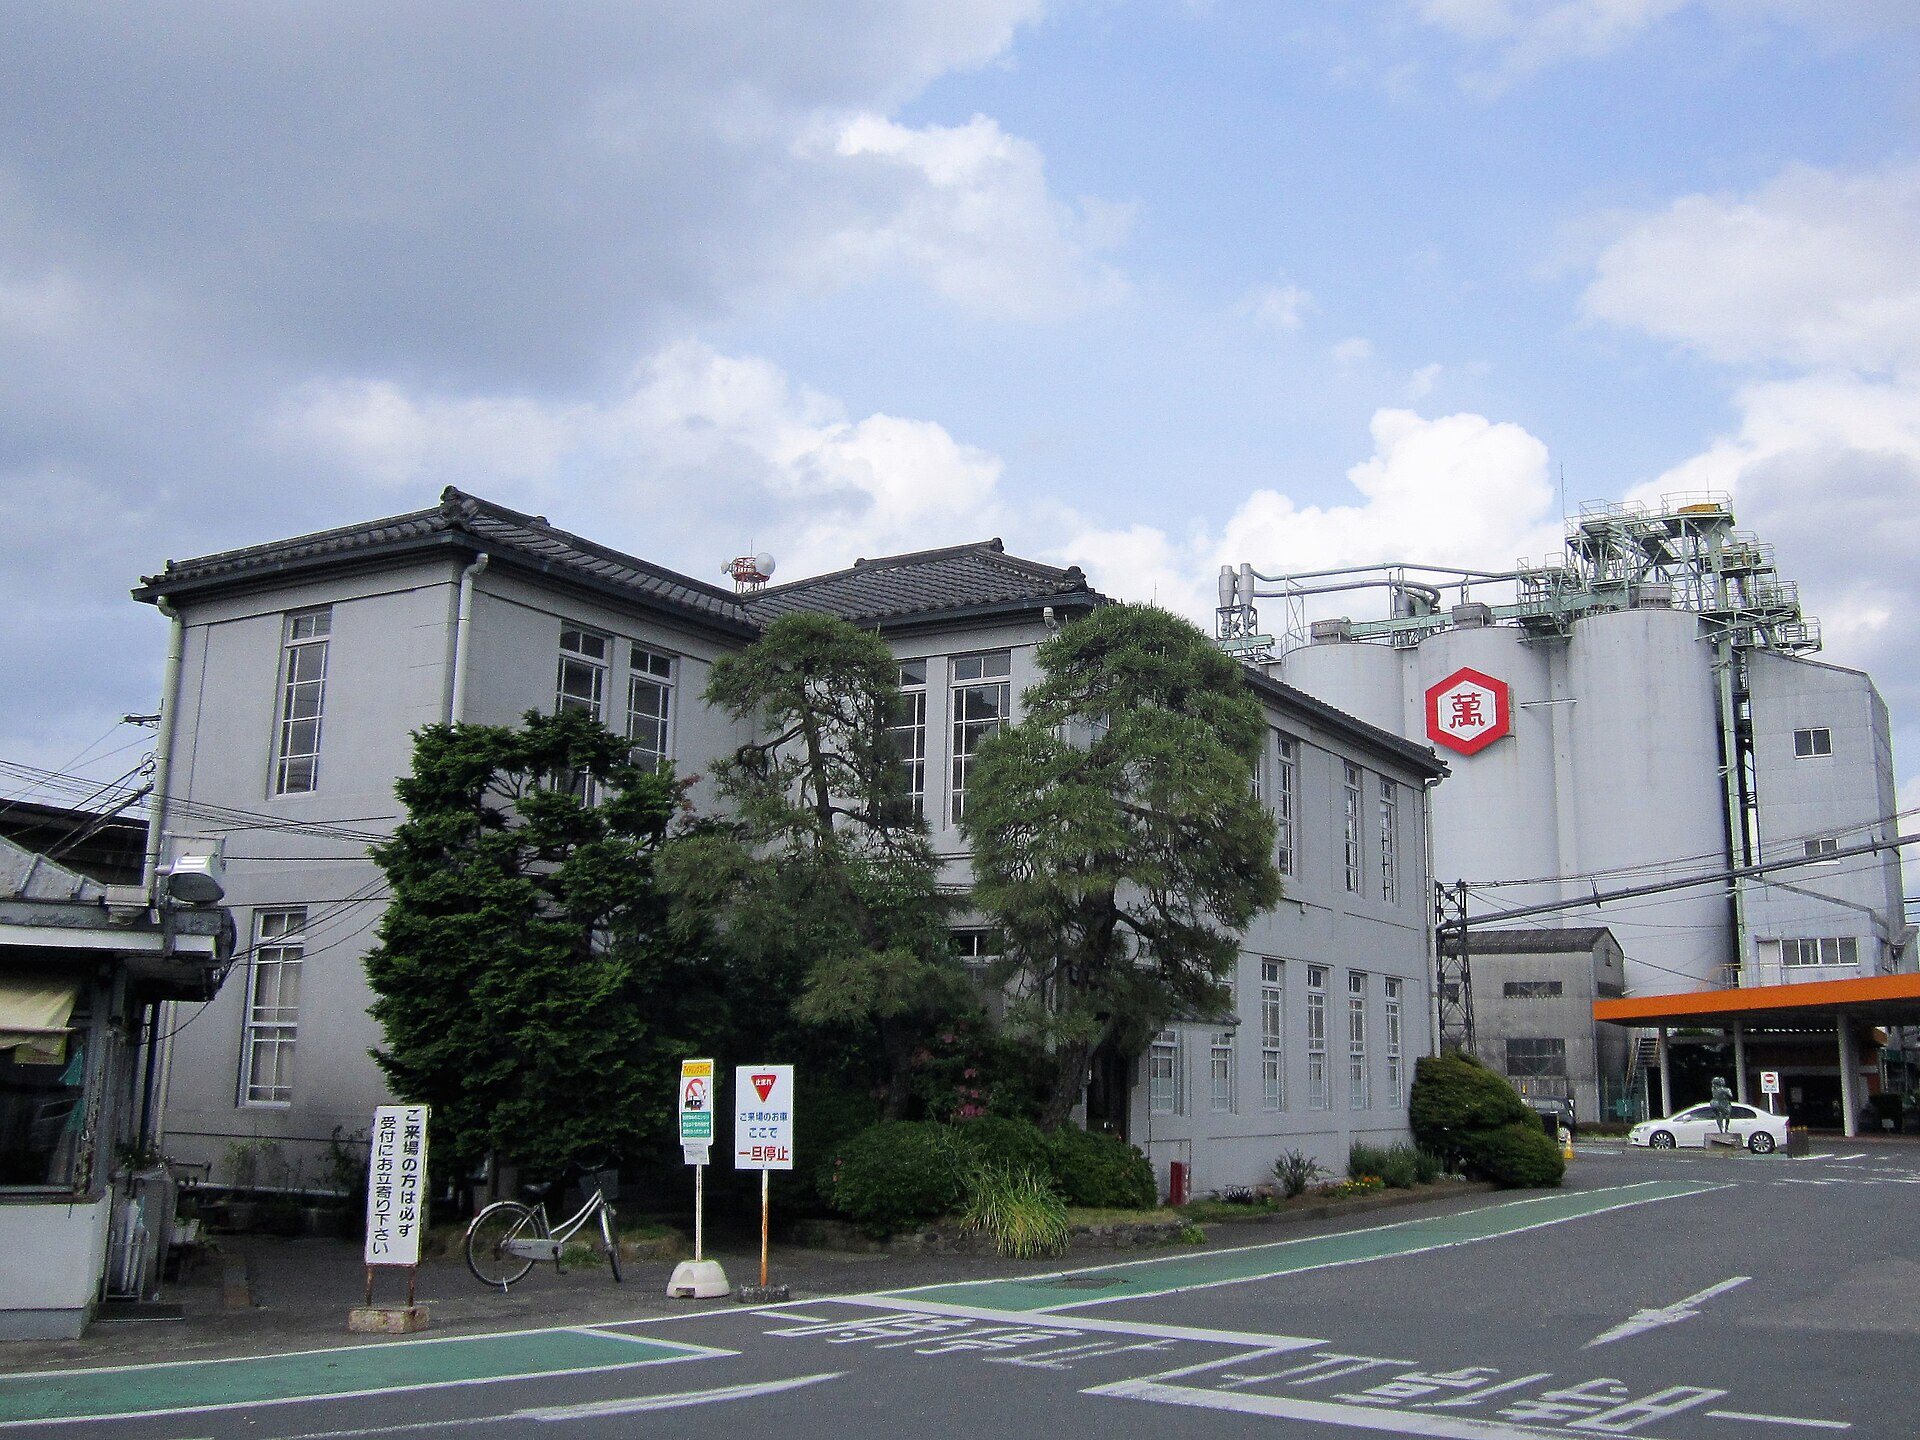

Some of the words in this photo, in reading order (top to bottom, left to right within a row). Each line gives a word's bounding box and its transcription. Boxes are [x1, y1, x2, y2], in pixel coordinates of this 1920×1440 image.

[749, 1127, 778, 1138] ここで
[738, 1146, 789, 1161] 一旦停止
[373, 1116, 396, 1254] 受付にお立寄り下さい
